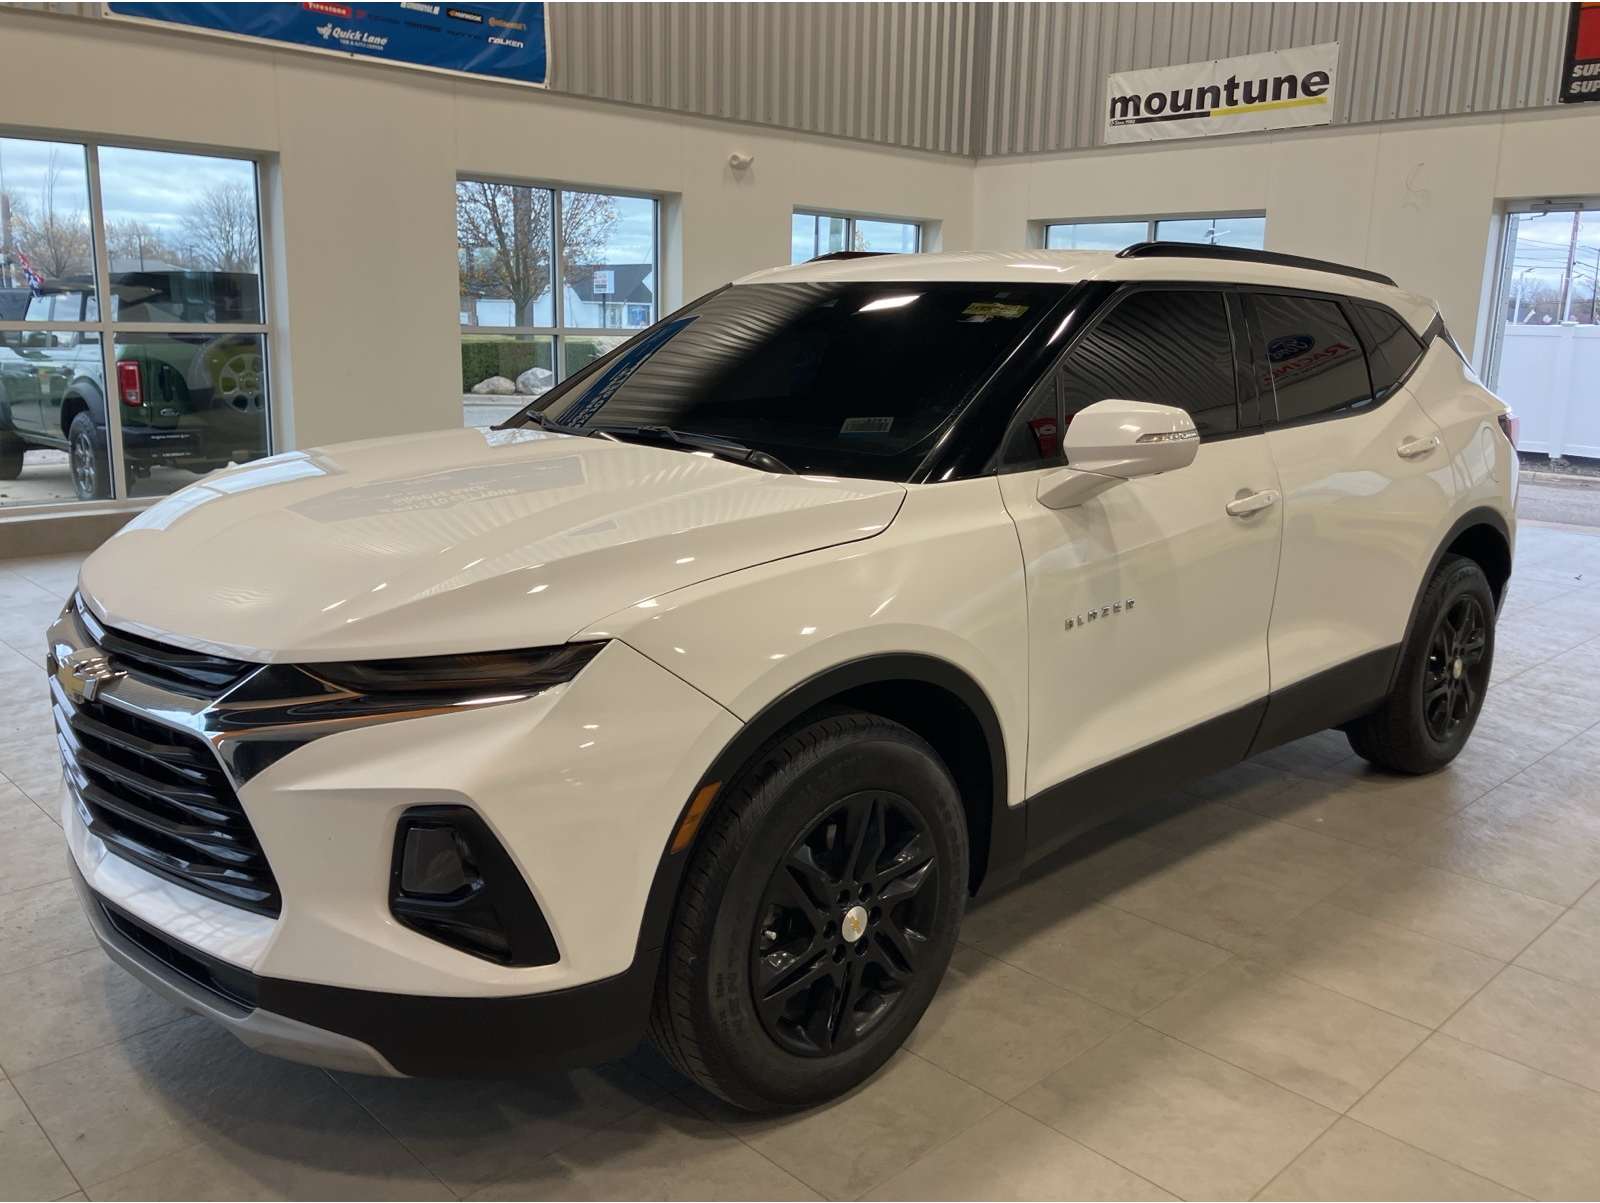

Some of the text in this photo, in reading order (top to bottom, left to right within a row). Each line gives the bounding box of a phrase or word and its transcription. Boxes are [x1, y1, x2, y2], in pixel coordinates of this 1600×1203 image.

[332, 27, 390, 46] Quick Lane
[1109, 70, 1330, 119] mountune
